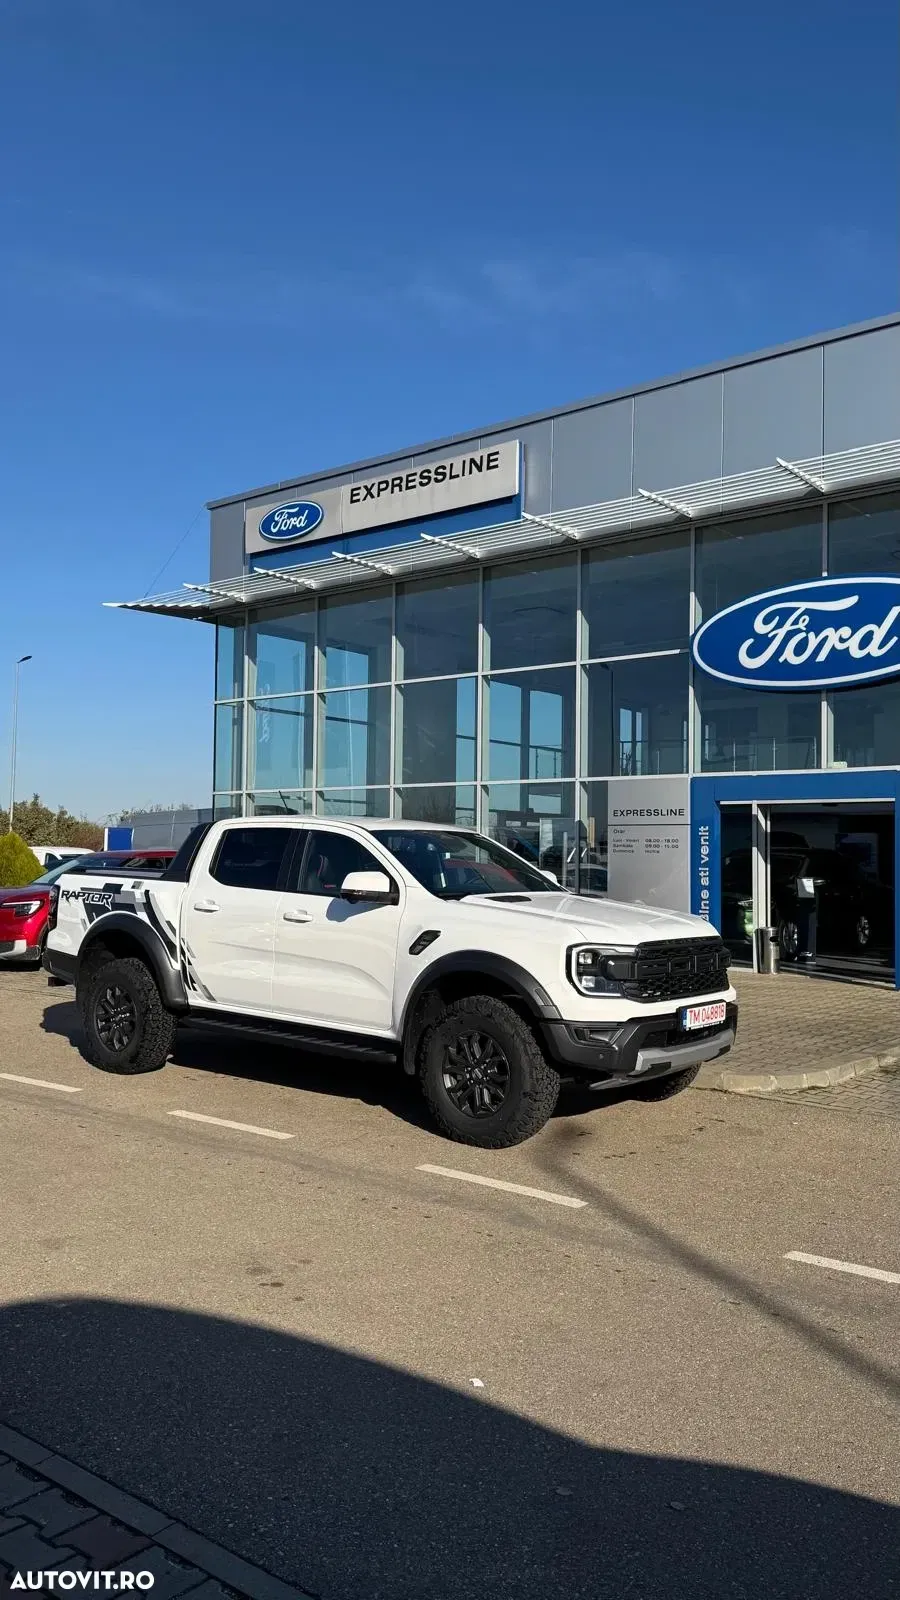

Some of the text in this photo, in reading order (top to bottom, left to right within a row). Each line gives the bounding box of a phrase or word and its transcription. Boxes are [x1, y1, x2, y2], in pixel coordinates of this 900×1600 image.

[349, 450, 500, 504] EXPRESSLINE
[270, 506, 308, 533] Ford
[738, 594, 900, 669] Ford
[613, 808, 685, 817] EXPRESSLINE
[699, 825, 710, 864] venit
[60, 889, 113, 910] RAPTOR
